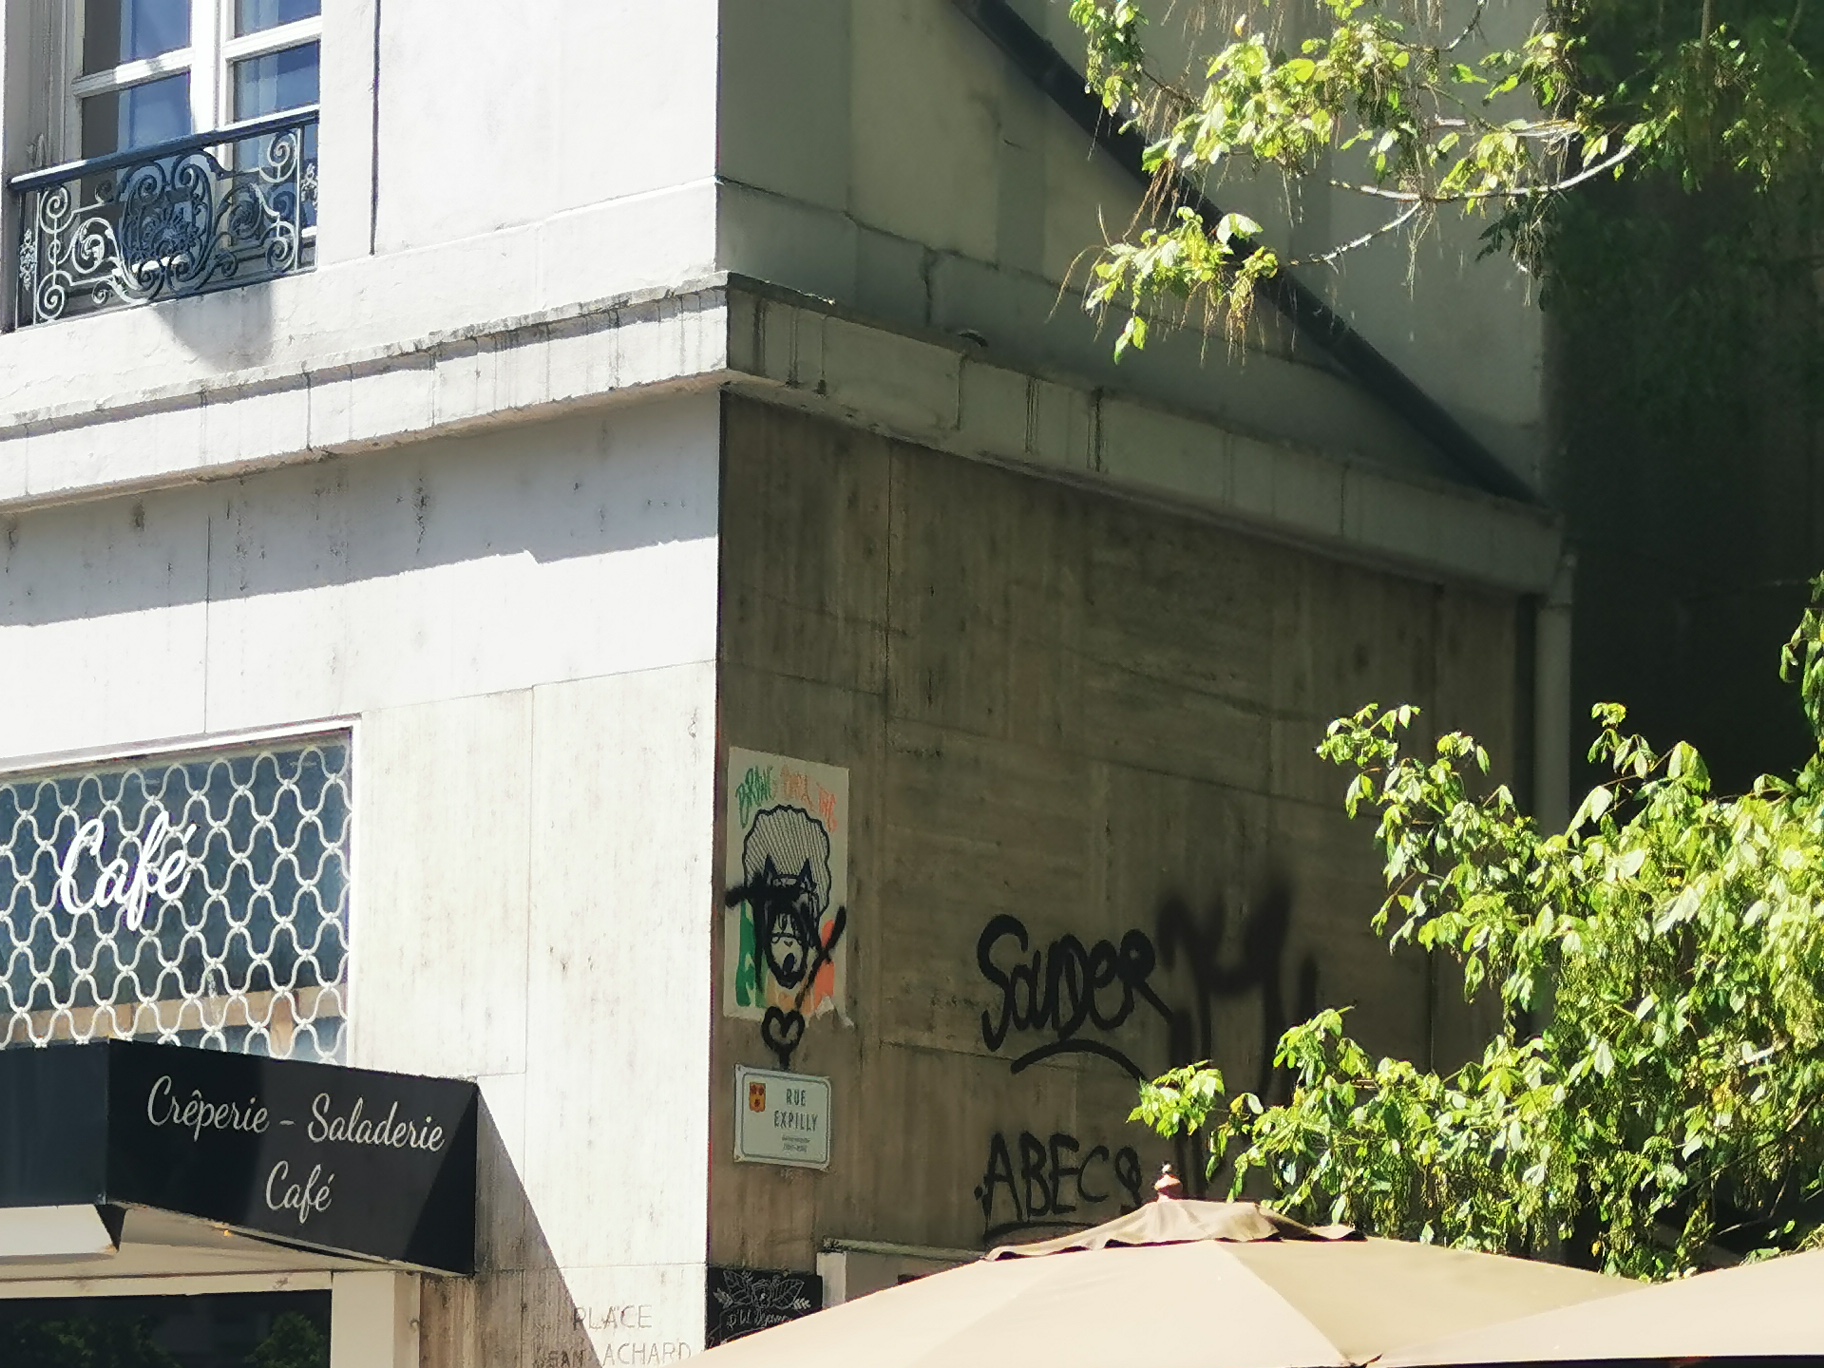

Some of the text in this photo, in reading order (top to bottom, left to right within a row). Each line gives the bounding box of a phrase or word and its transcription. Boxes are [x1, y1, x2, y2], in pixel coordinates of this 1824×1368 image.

[61, 811, 197, 930] Café
[147, 1075, 270, 1142] Crêperie
[307, 1093, 445, 1153] Saladerie
[785, 1088, 807, 1107] RUE
[773, 1109, 819, 1132] EXPILLY
[265, 1161, 334, 1223] Café
[603, 1341, 692, 1367] ACHARD
